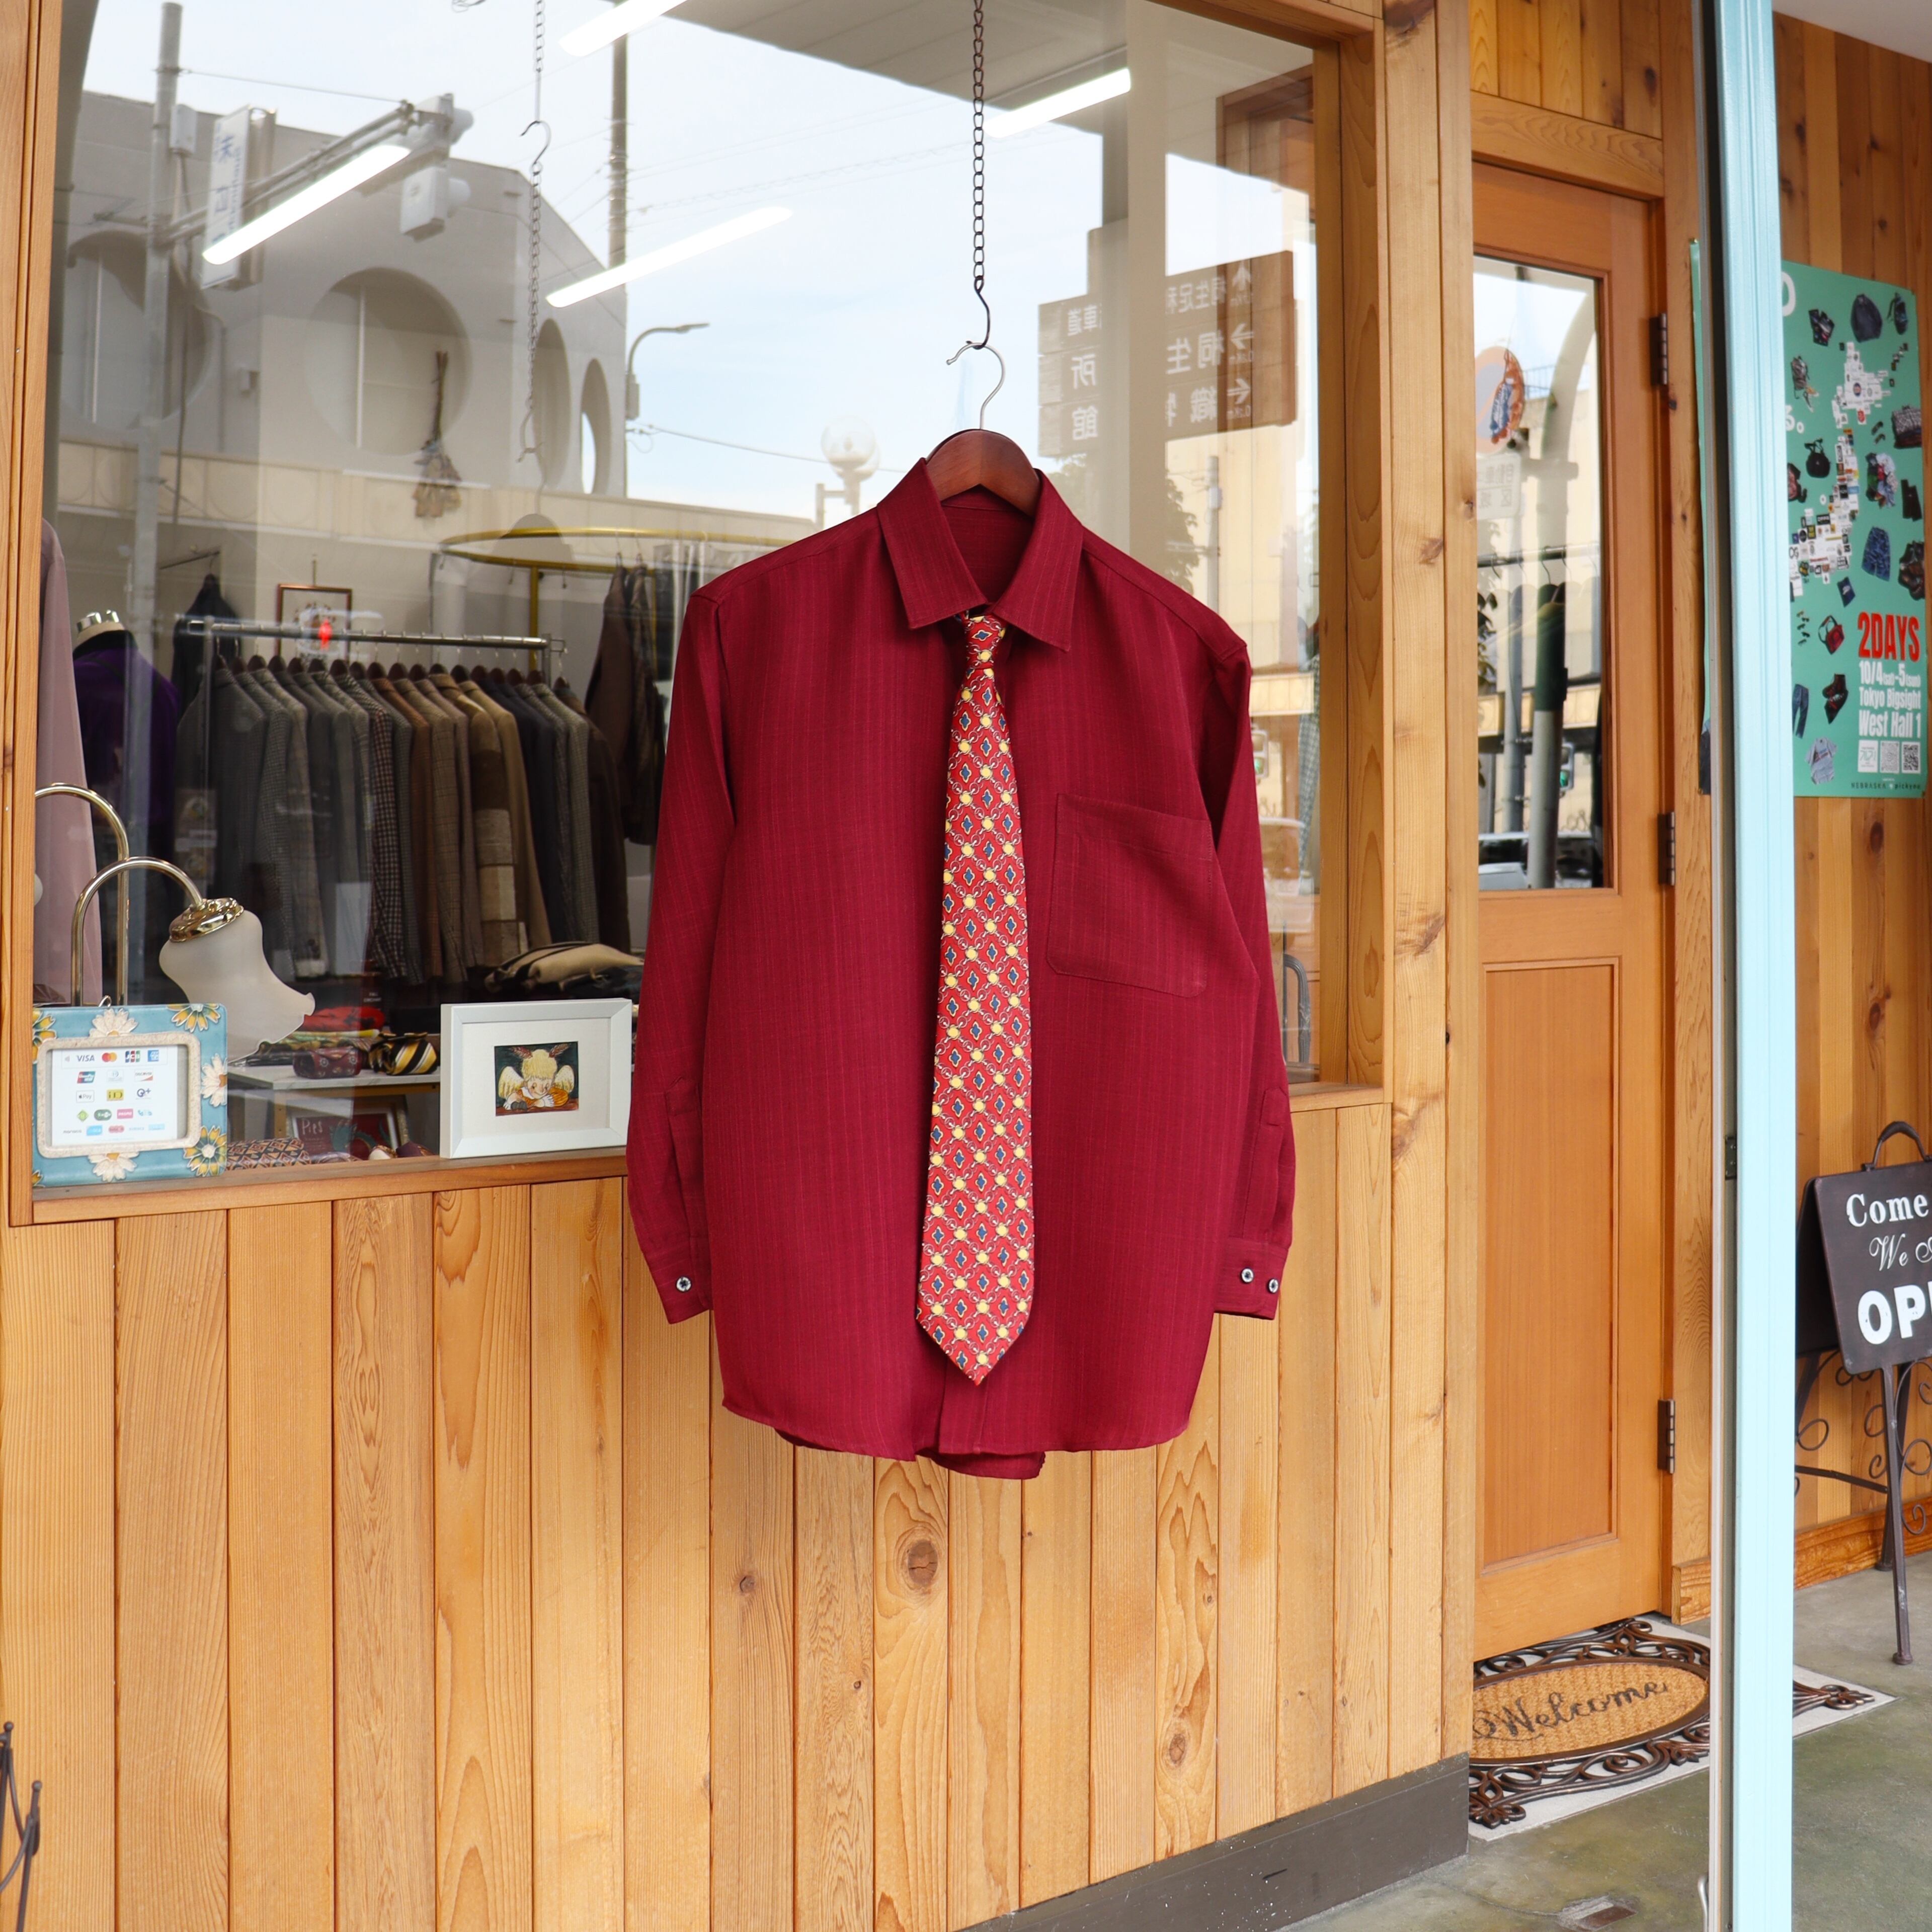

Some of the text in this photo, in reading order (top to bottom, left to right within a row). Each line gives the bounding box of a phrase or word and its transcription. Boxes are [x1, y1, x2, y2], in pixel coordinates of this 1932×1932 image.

[1858, 611, 1920, 662] 2DAYS
[1859, 686, 1885, 709] Tokyo
[1859, 709, 1921, 738] West Hall 1
[1846, 1193, 1928, 1227] Come
[1869, 1234, 1908, 1271] We
[1858, 1281, 1932, 1345] OP
[1473, 1681, 1668, 1741] Welcome
